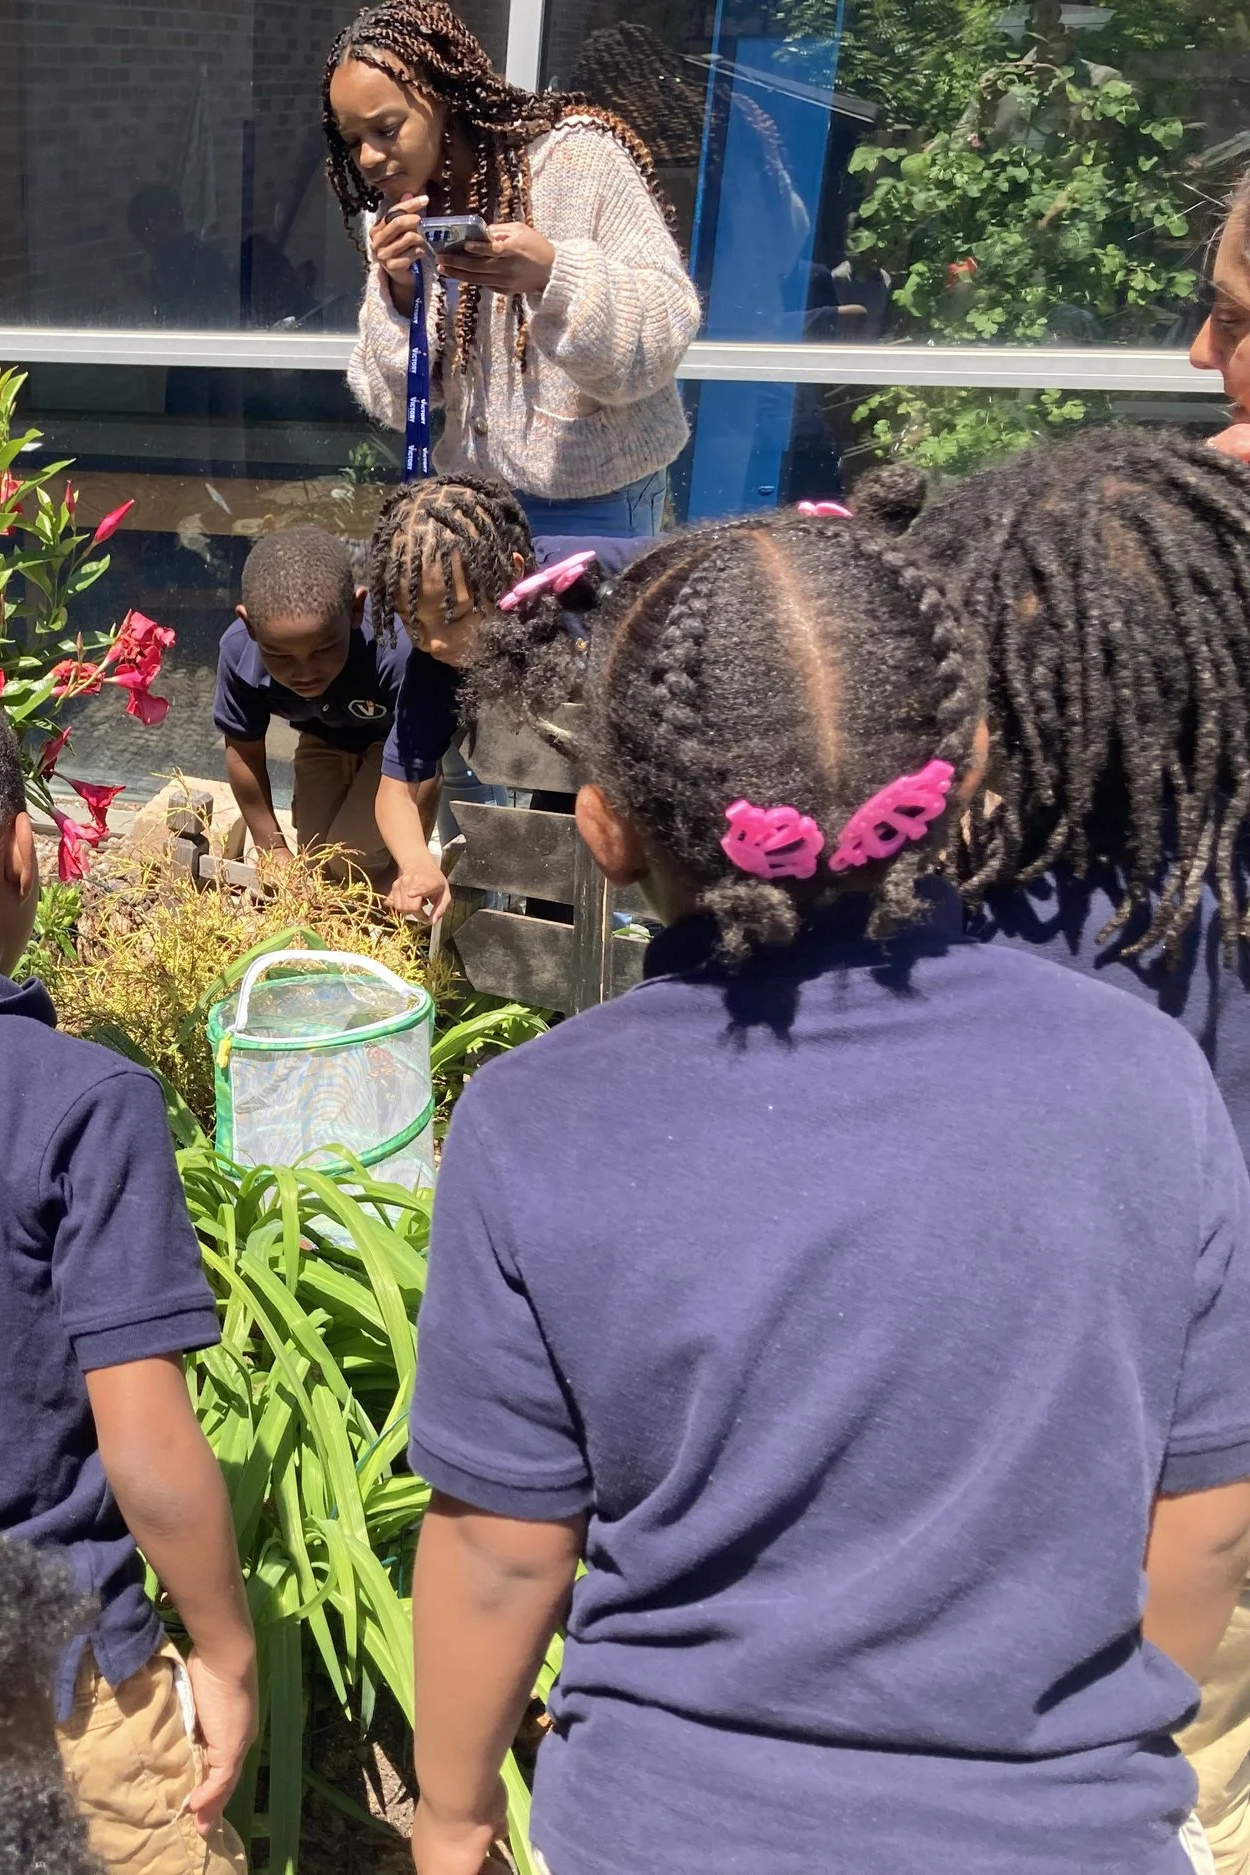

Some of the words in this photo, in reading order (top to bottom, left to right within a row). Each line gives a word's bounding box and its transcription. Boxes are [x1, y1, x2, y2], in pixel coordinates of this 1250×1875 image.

[411, 347, 421, 374] VICTORY
[409, 396, 418, 423] VICTORY
[406, 445, 416, 470] VICTORY
